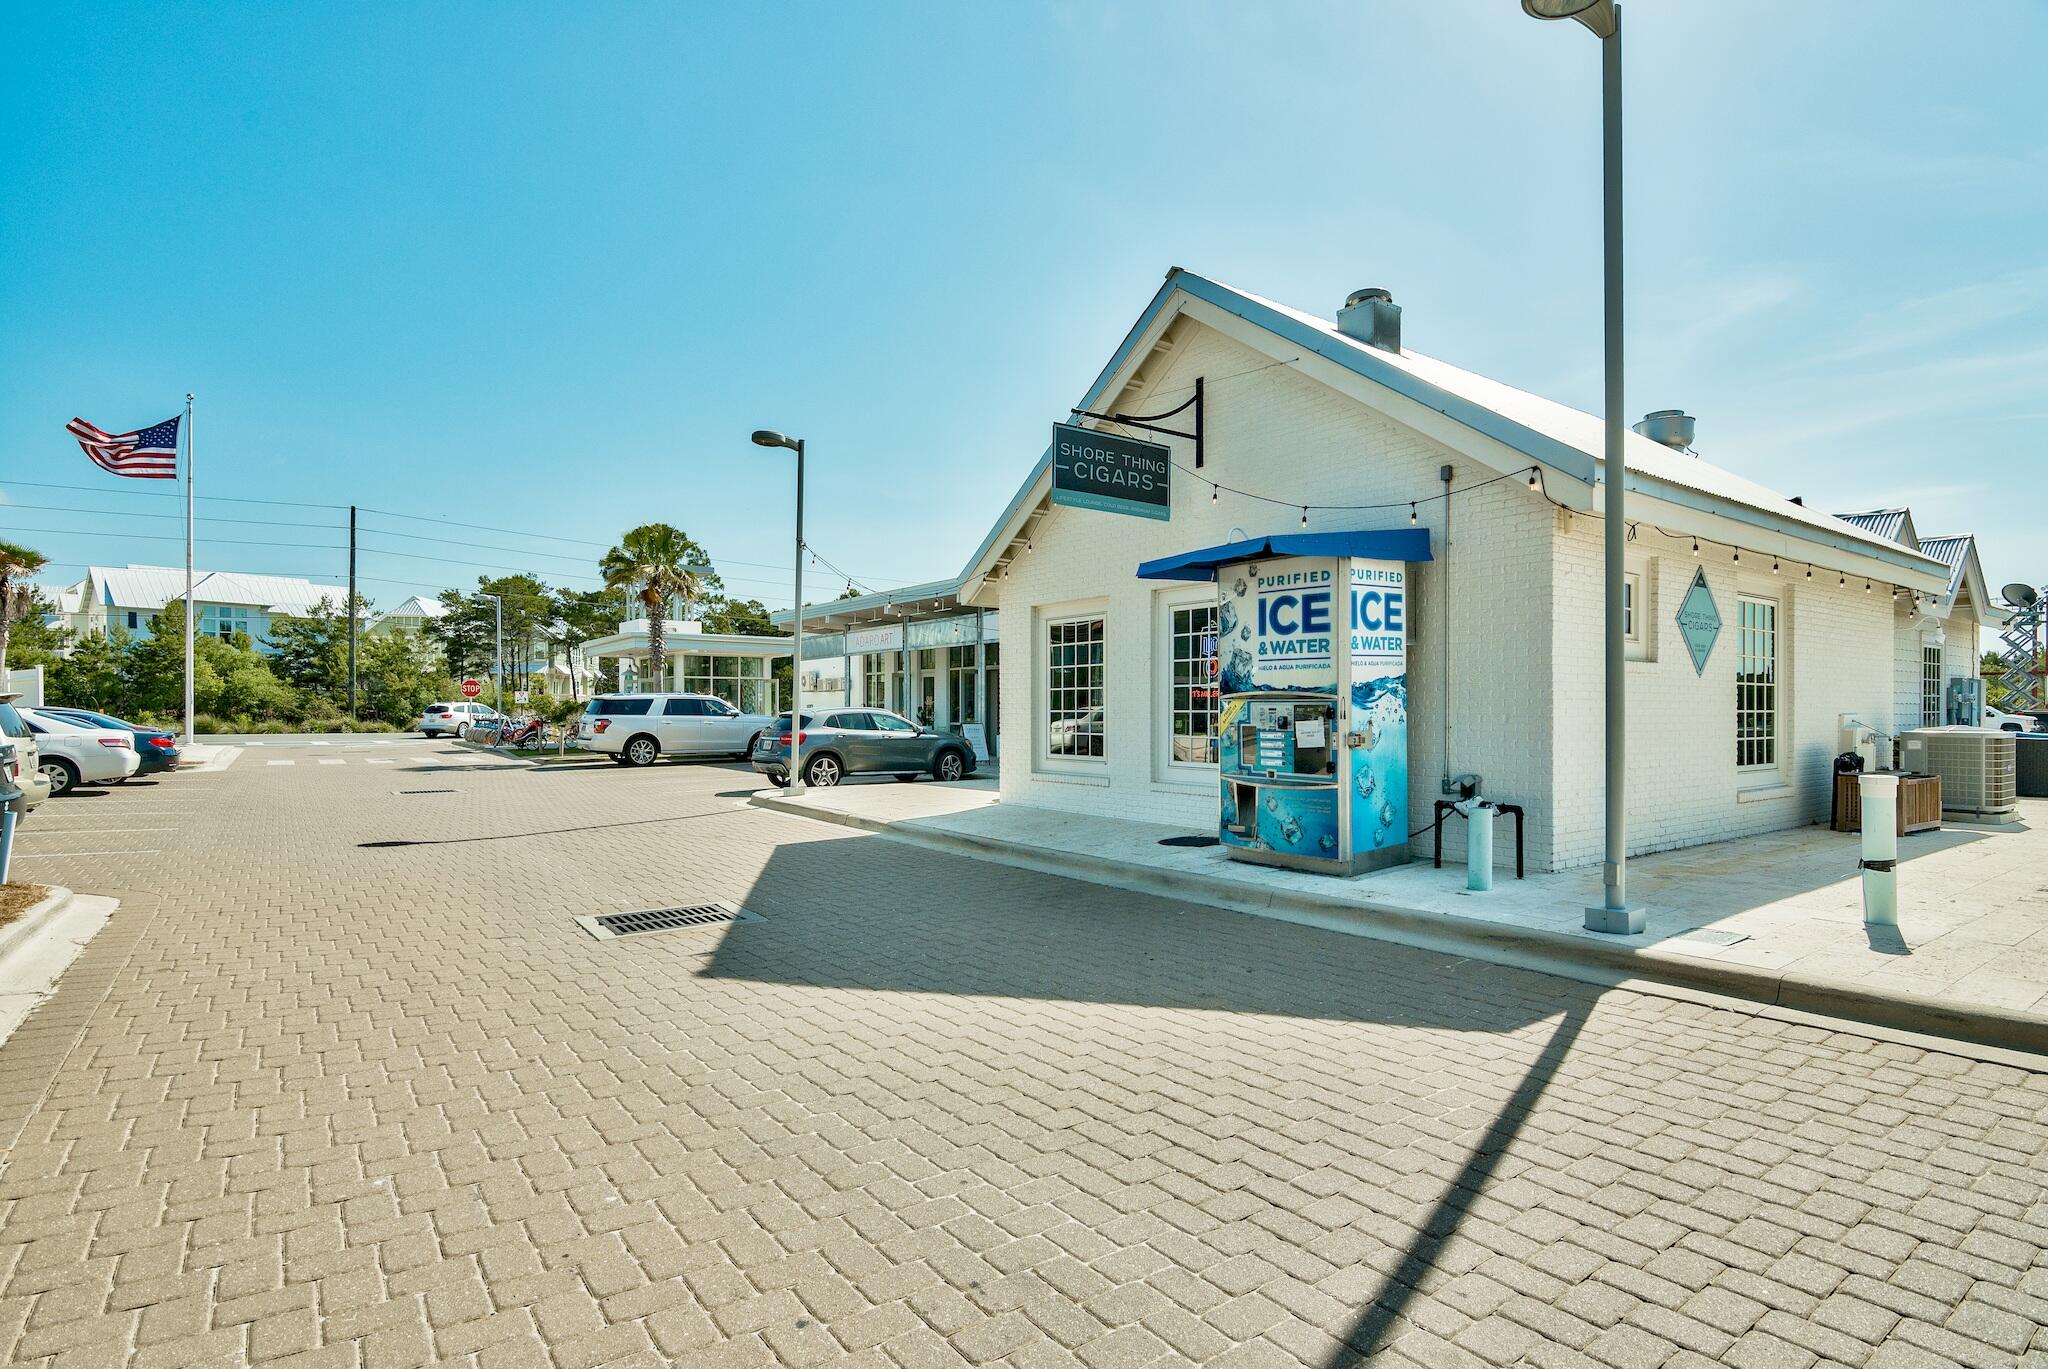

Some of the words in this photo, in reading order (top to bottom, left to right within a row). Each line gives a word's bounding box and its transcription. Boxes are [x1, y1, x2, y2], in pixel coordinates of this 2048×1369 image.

[1060, 442, 1115, 464] SHORE
[1122, 454, 1166, 474] THING
[1074, 461, 1154, 491] CIGARS
[1258, 570, 1331, 588] PURIFIED
[1350, 568, 1403, 583] PURIFIED
[1258, 592, 1331, 636] ICE
[1351, 590, 1403, 632] ICE
[1685, 611, 1701, 621] SHORE
[1688, 620, 1713, 632] CIGARS
[1258, 641, 1268, 656] &
[1270, 638, 1330, 655] WATER
[1351, 635, 1359, 650] &
[1361, 636, 1403, 651] WATER
[462, 684, 480, 693] STOP
